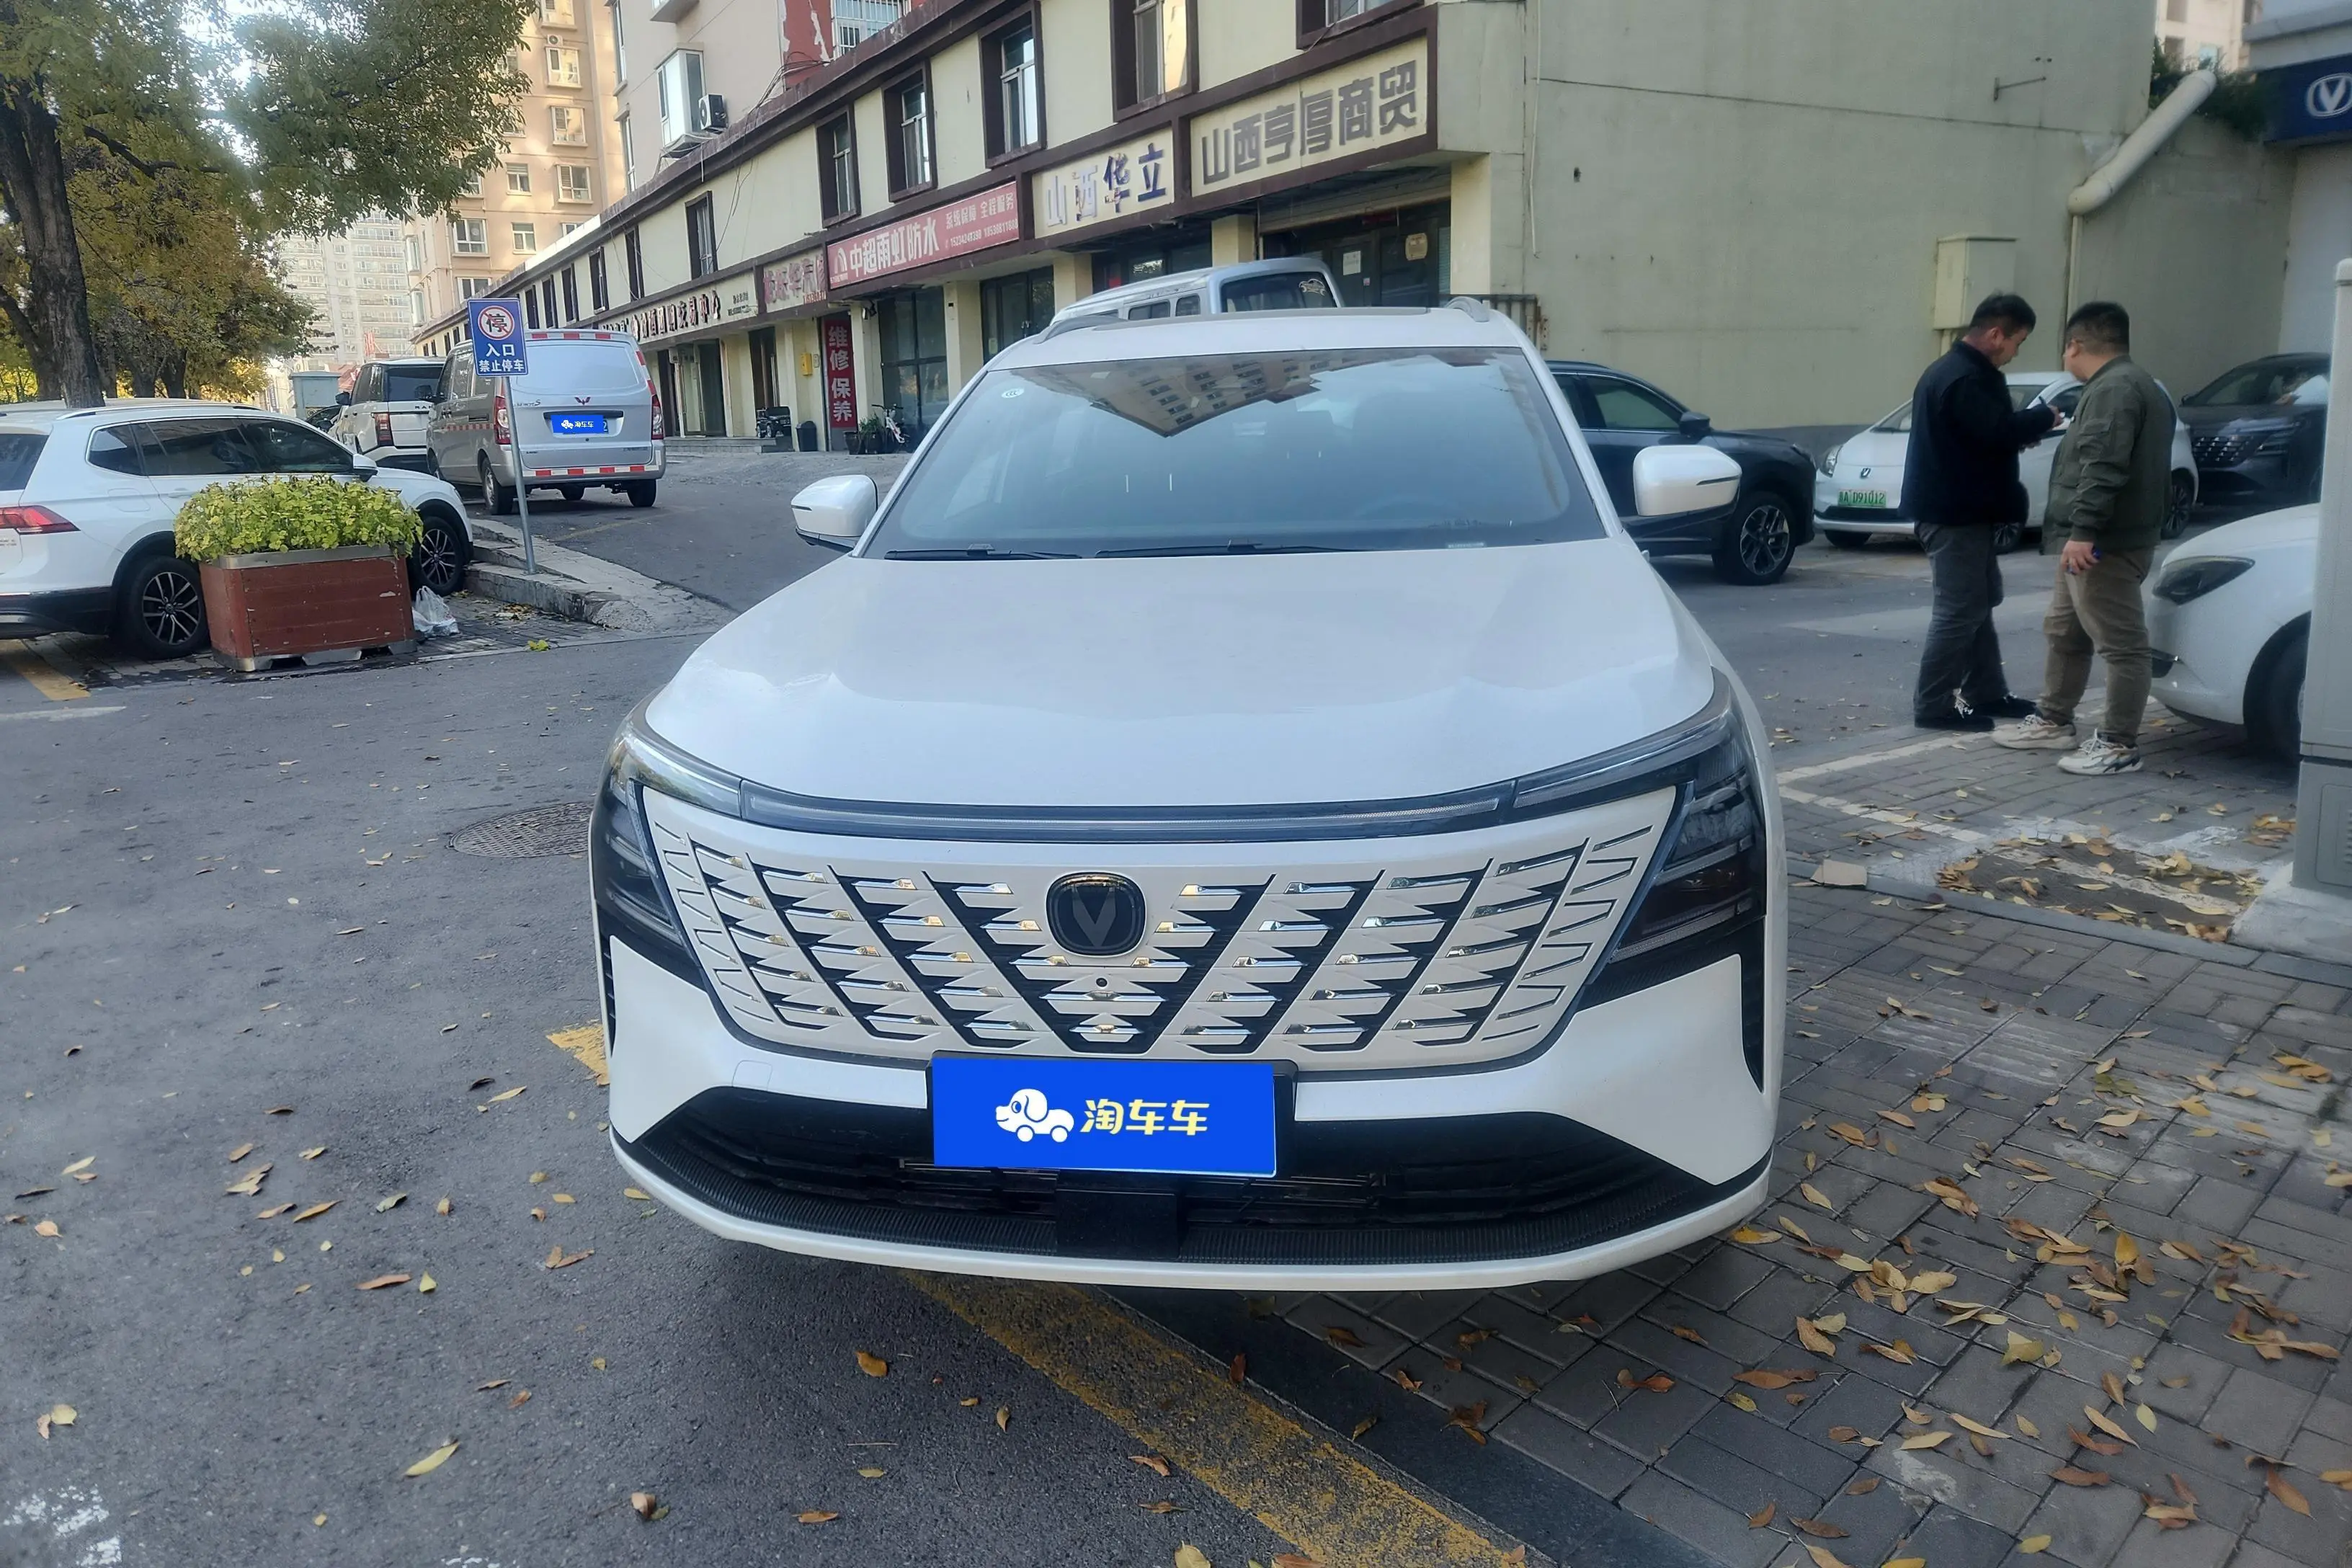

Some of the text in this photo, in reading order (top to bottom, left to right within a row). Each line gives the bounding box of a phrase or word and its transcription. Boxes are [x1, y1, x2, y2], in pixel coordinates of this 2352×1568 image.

[1201, 60, 1417, 186] 山西亨厚商贸
[1046, 142, 1167, 228] 山西华立
[945, 192, 1015, 230] 系统保障 全程服务
[850, 216, 940, 278] 中超雨虹防水
[478, 359, 525, 373] 禁止停车
[486, 343, 515, 357] 入口
